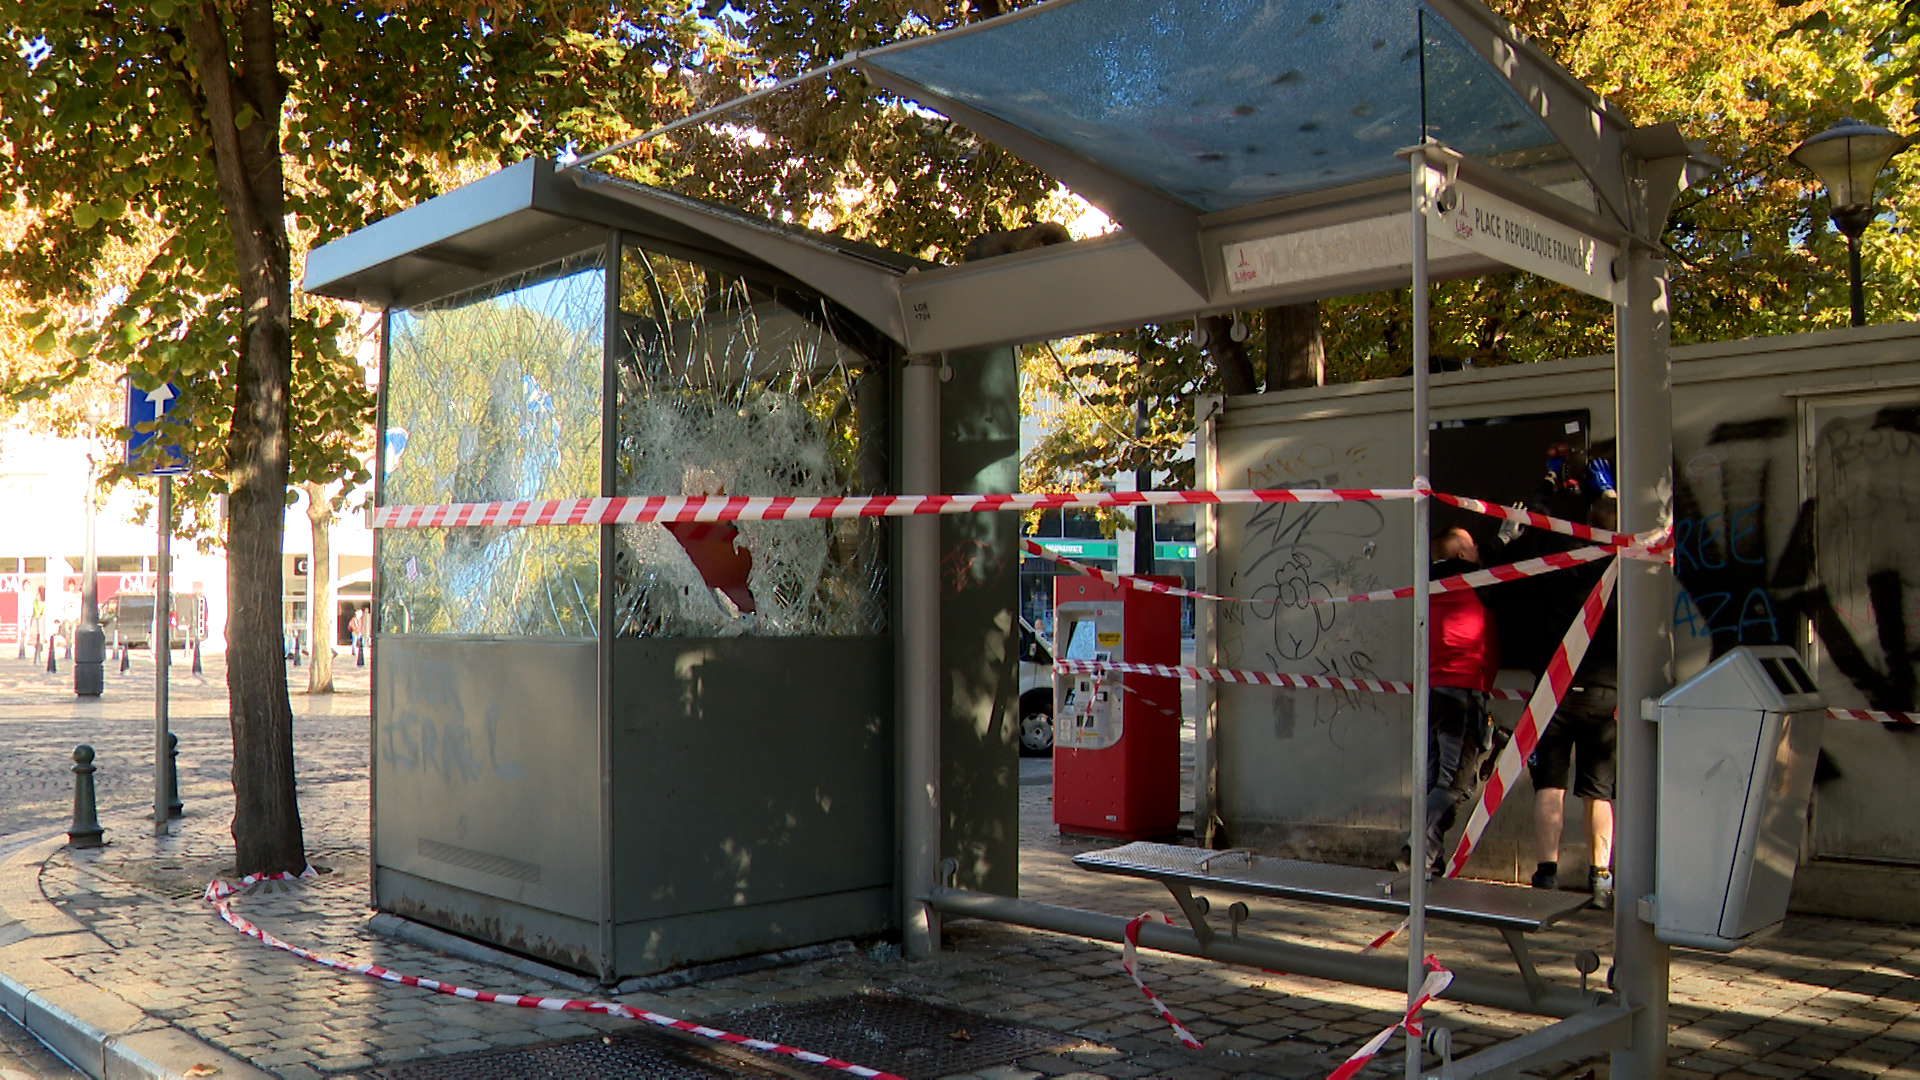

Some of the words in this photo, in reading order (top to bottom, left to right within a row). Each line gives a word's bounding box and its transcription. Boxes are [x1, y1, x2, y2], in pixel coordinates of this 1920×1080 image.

[1475, 207, 1502, 240] PLACE
[1504, 219, 1553, 260] REPUBLIQUE
[1553, 239, 1592, 275] FRANCAI
[1673, 503, 1765, 577] REE
[1673, 587, 1779, 643] AZA
